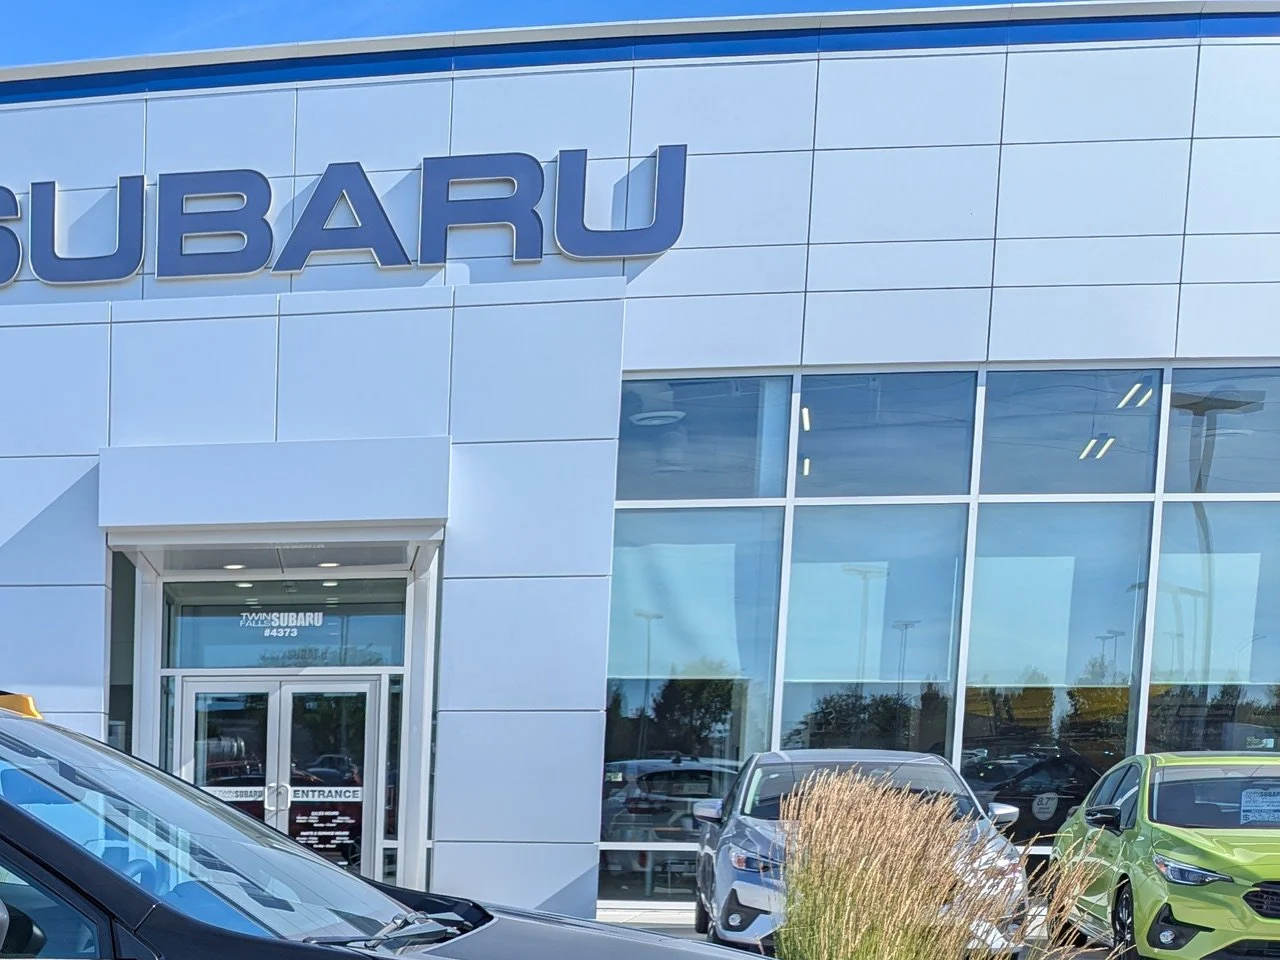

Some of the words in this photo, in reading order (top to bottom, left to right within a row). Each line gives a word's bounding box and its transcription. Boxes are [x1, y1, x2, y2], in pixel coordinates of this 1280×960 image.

[241, 612, 272, 620] TWIN
[271, 612, 323, 627] SUBARU
[264, 628, 298, 637] #4373
[293, 789, 360, 799] ENTRANCE
